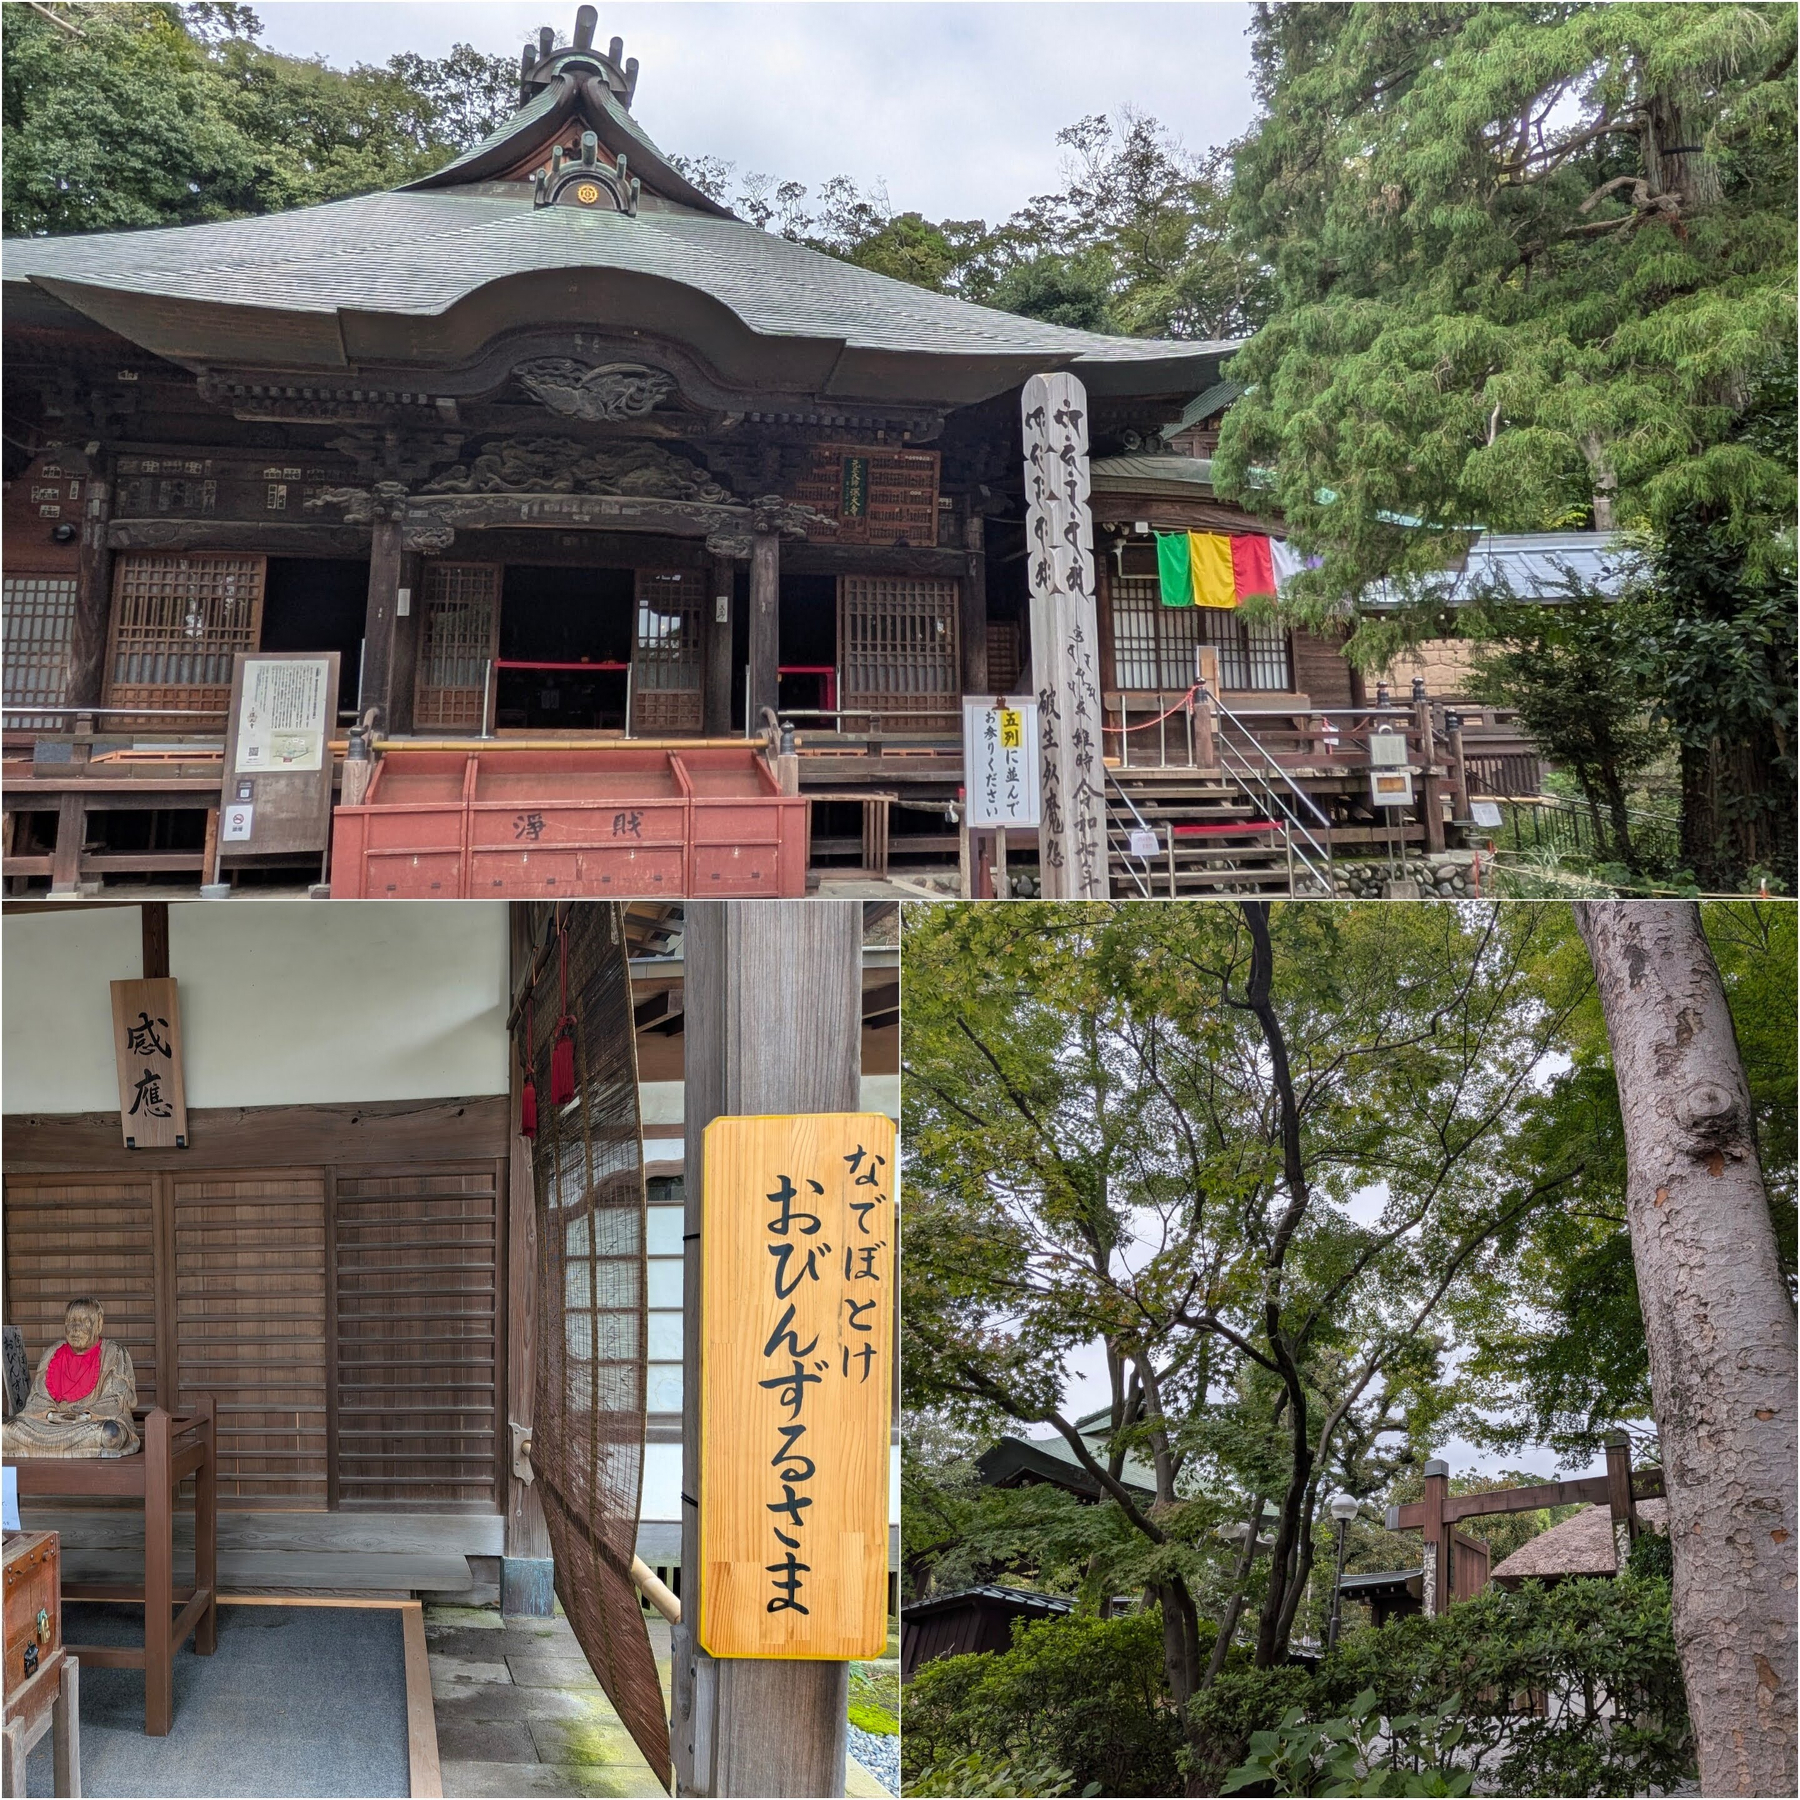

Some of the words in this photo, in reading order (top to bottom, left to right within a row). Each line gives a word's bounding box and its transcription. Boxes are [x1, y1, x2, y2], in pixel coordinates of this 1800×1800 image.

[984, 711, 999, 818] お参りください
[1003, 712, 1021, 818] 五列に並んで
[842, 1143, 887, 1386] なでぼとけ
[757, 1174, 832, 1616] おびんずるさま
